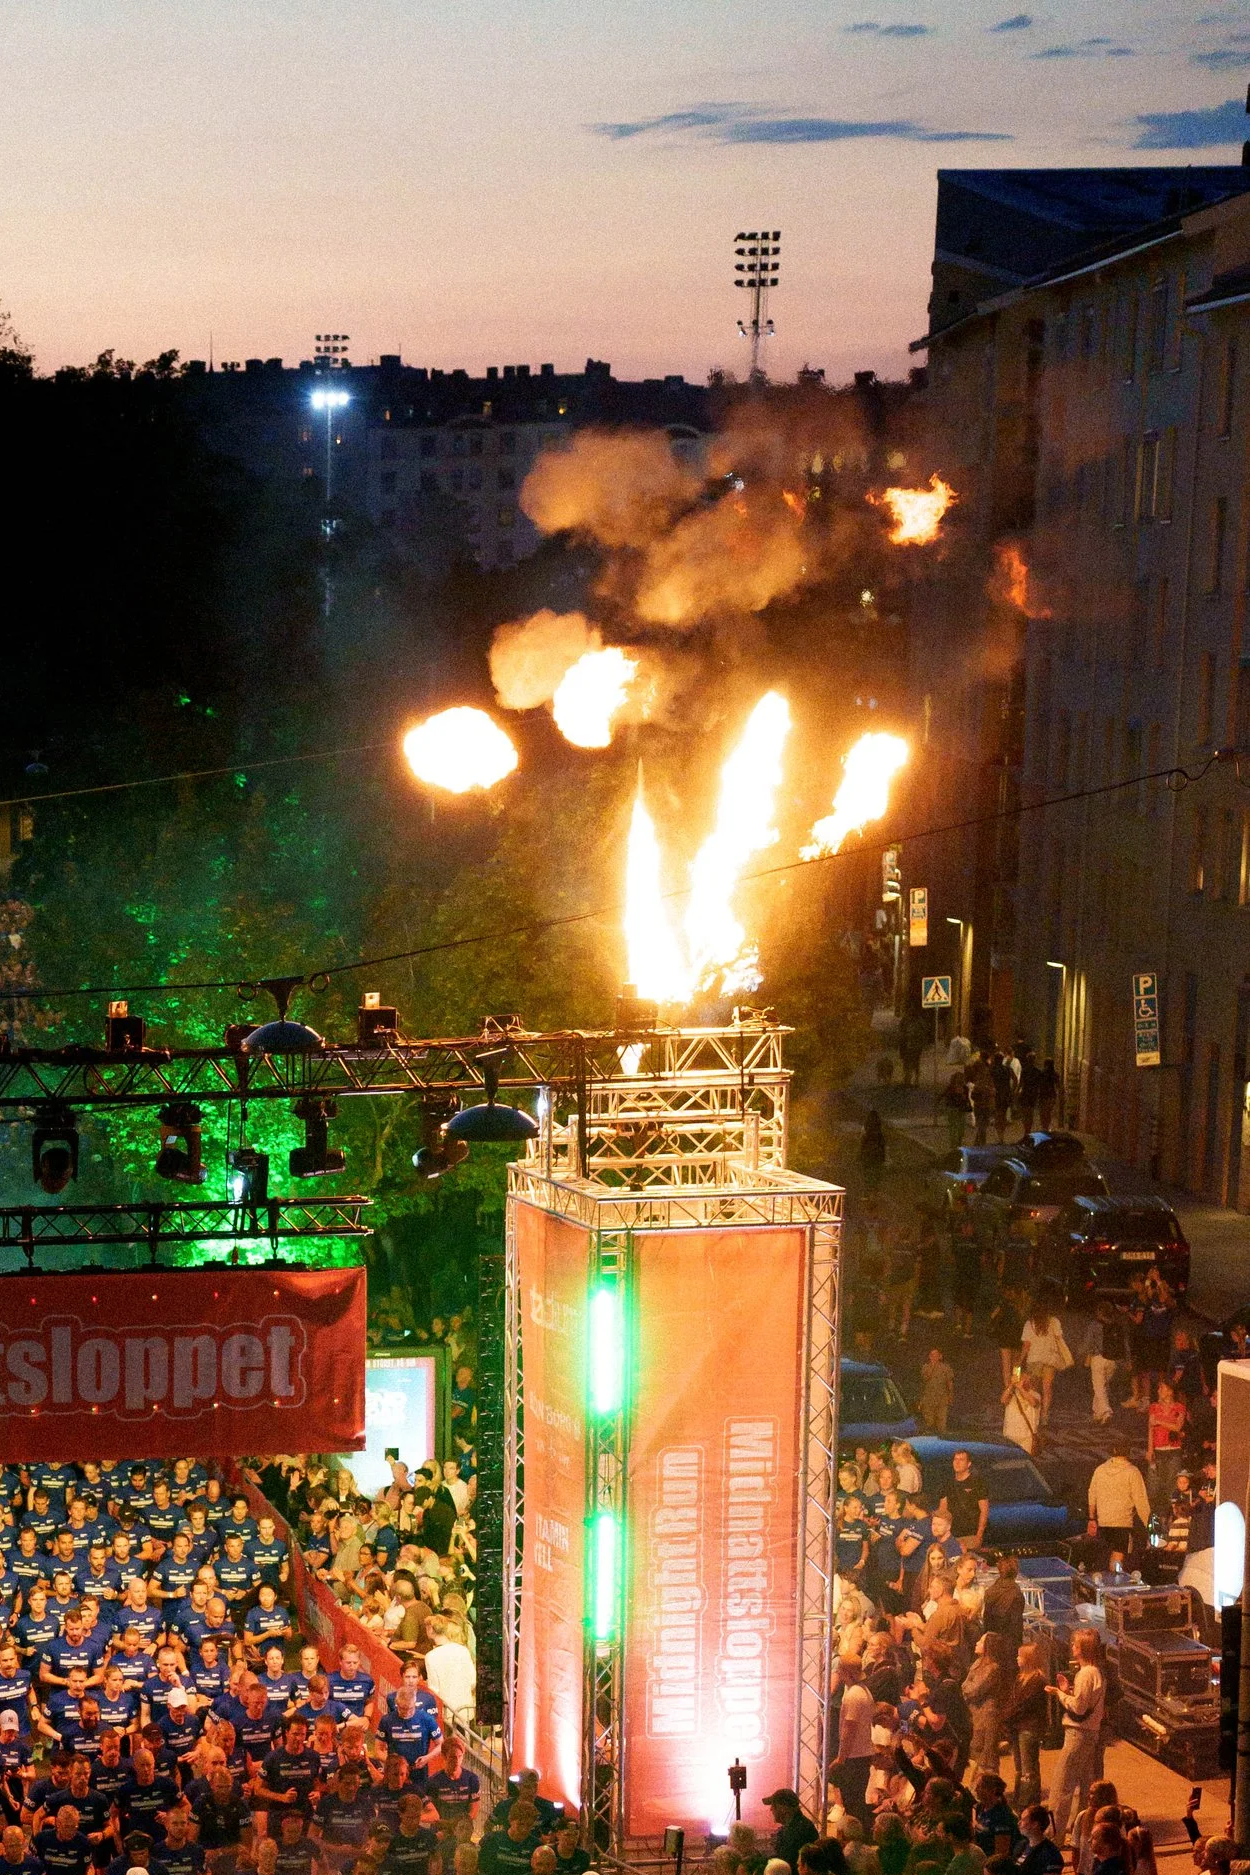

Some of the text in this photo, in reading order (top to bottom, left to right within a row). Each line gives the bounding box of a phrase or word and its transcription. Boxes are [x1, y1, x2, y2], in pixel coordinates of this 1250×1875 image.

[1139, 976, 1152, 995] P
[651, 1452, 701, 1733] Midnight Run
